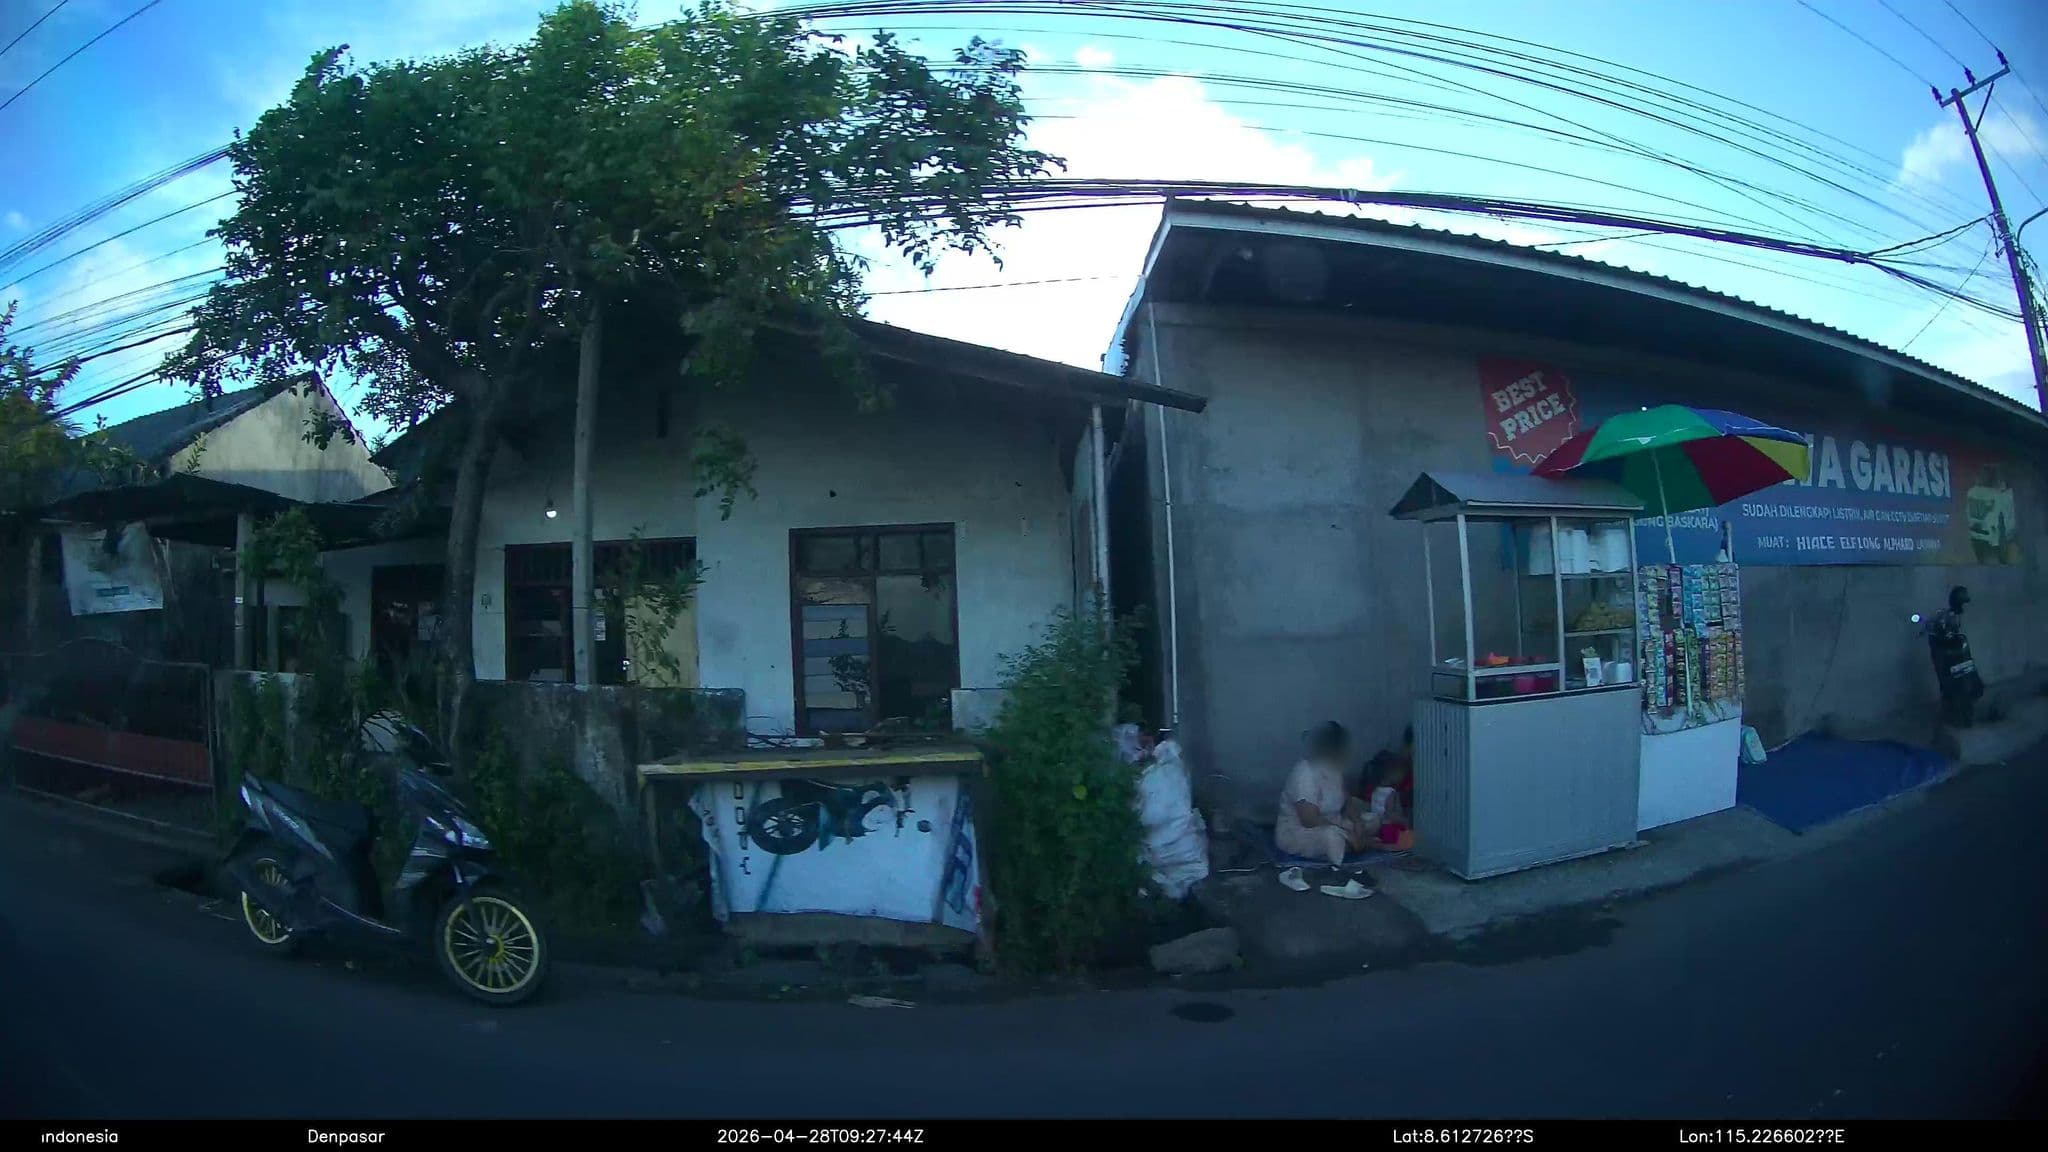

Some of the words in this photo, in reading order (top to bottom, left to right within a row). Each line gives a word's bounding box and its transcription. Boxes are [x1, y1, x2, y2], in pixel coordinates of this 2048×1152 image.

[1491, 371, 1547, 412] BEST
[1500, 392, 1566, 441] PRICE
[1850, 439, 1951, 498] GARASI
[1667, 515, 1719, 533] BASKARA)
[1741, 503, 1778, 518] SUDAH
[1779, 504, 1832, 519] DILENGKAPI
[1796, 536, 1836, 551] HIACE
[1858, 536, 1881, 550] LONG
